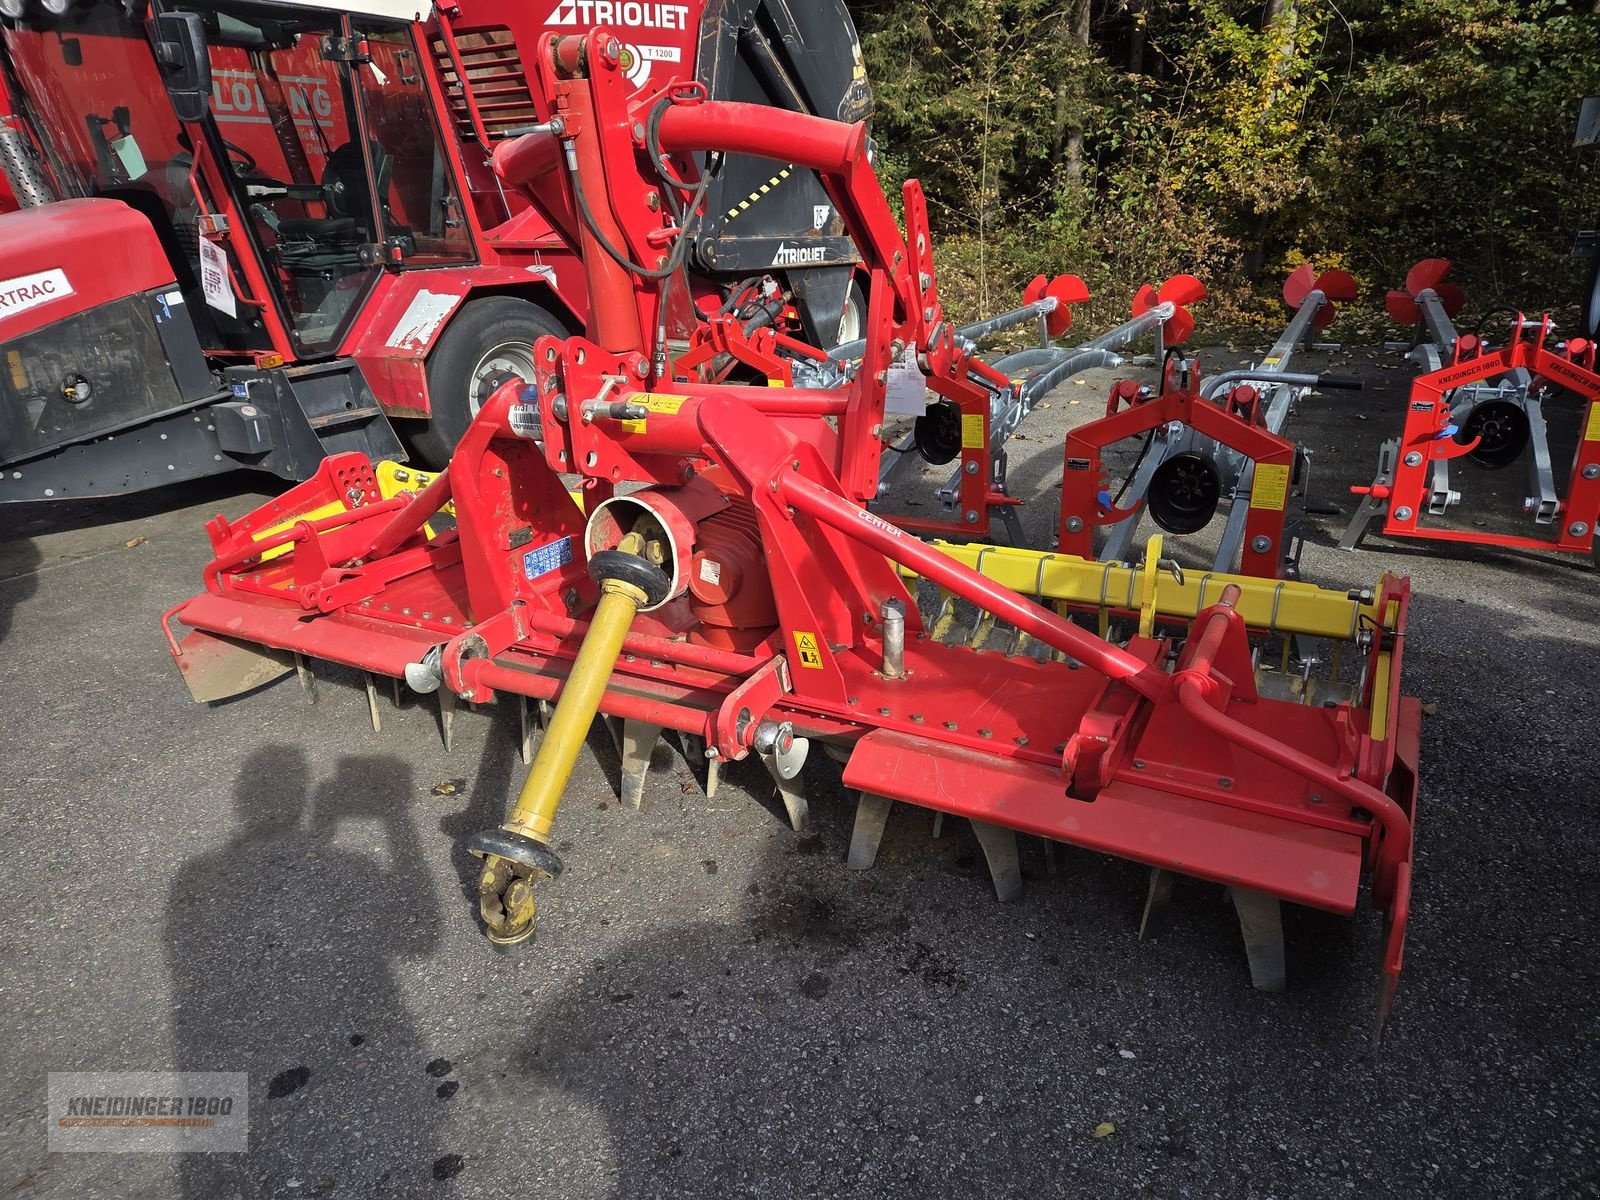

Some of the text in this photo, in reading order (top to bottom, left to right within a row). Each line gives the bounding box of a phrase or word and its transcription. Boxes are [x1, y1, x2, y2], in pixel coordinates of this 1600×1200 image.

[577, 1, 689, 30] TRIOLIET
[655, 49, 673, 58] 1200
[783, 246, 826, 264] TRIOLIET
[1438, 365, 1482, 385] KNEIDINGER
[858, 511, 902, 537] CENTER
